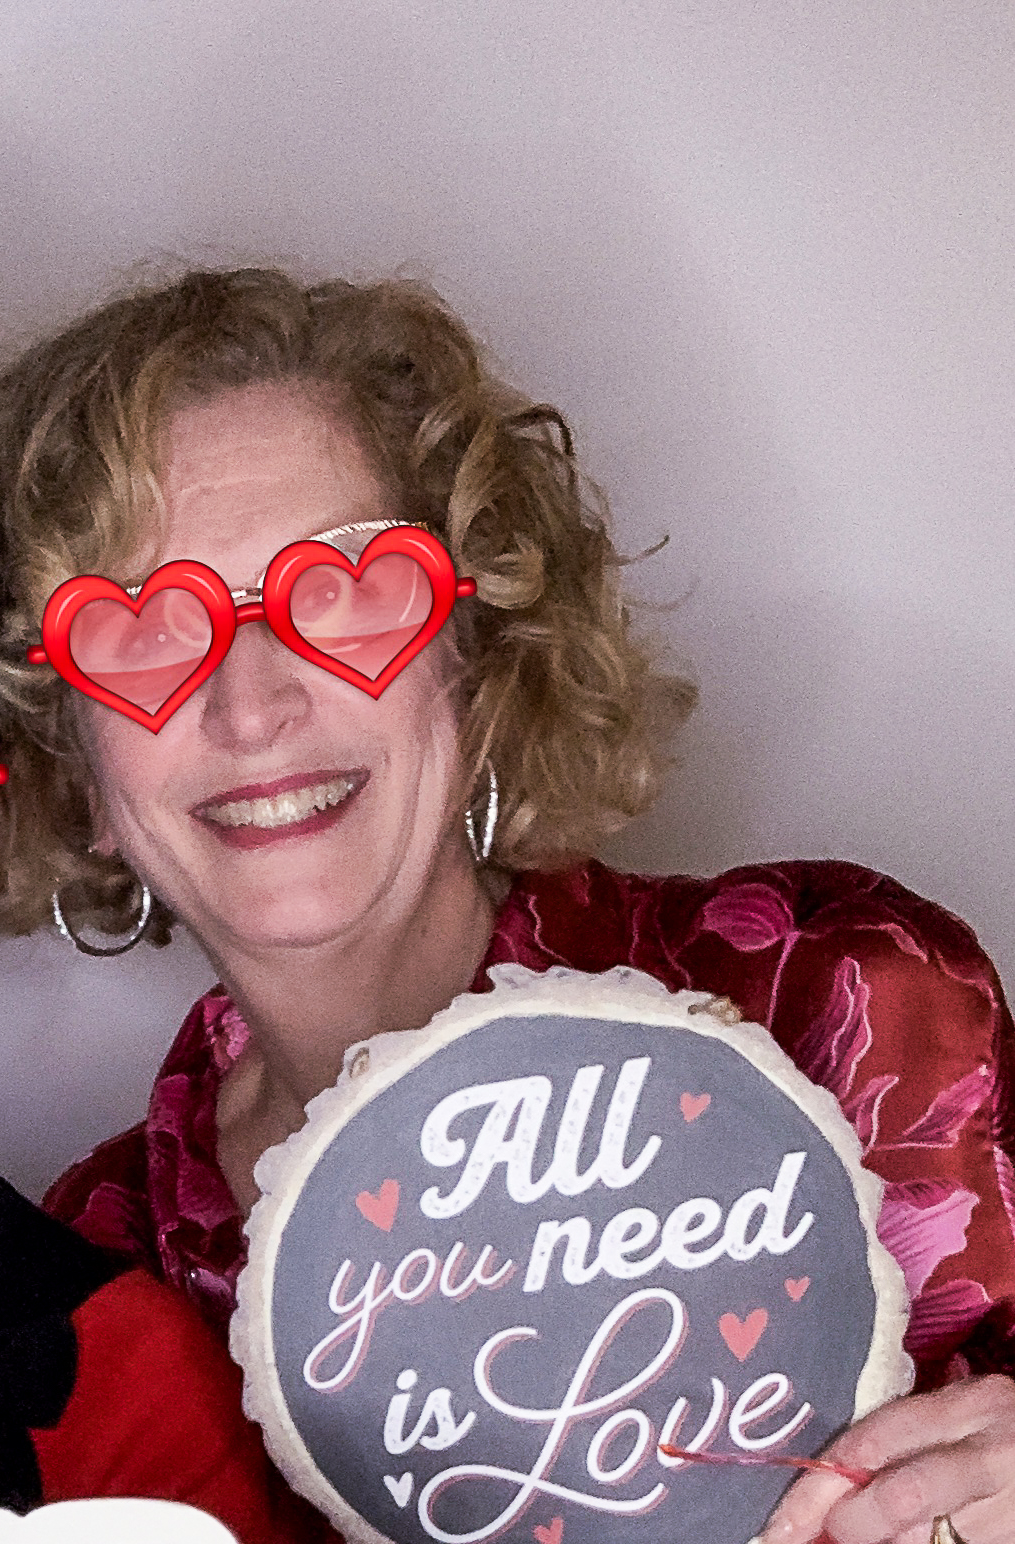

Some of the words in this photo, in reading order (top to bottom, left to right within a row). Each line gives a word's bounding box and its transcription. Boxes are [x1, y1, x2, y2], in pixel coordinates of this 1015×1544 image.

[419, 1055, 662, 1219] All
[302, 1241, 514, 1392] you
[523, 1151, 815, 1293] need
[383, 1368, 477, 1455] is
